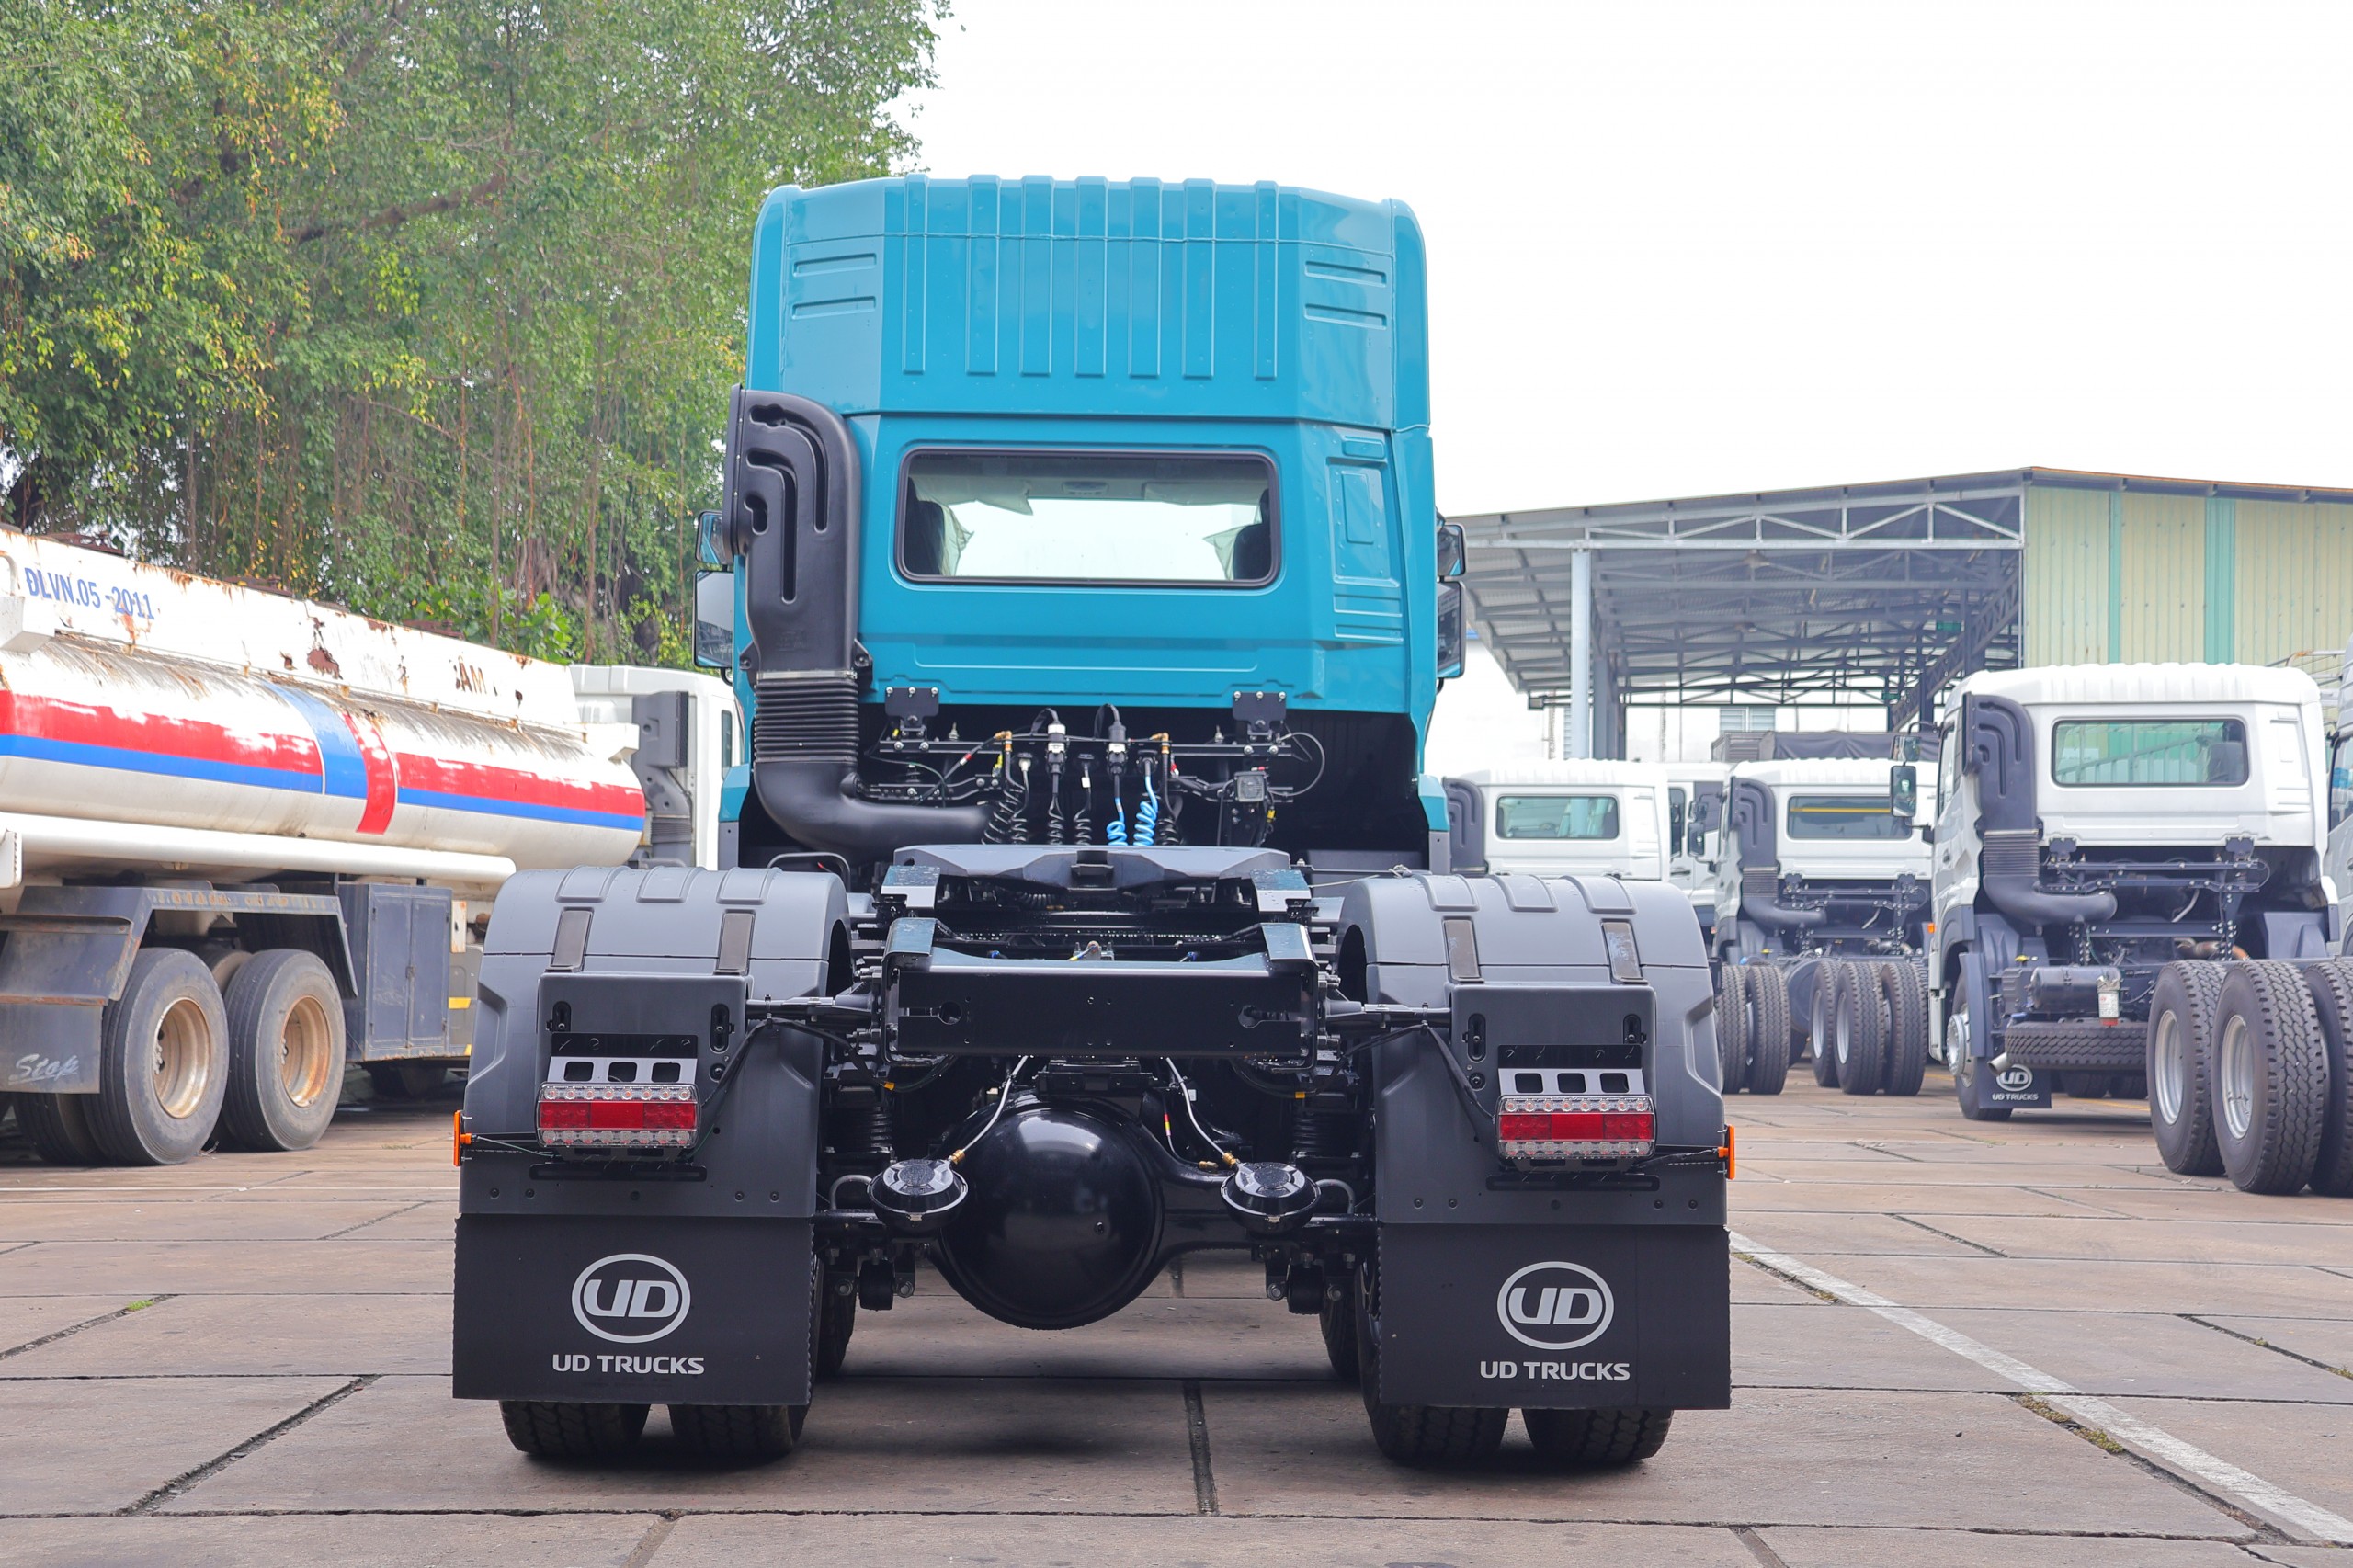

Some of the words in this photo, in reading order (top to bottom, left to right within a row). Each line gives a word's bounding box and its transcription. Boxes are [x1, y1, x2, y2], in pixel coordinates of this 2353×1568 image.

[1991, 1093, 2005, 1101] UD
[2006, 1093, 2040, 1101] TRUCKS
[583, 1279, 679, 1317] UD
[1508, 1287, 1594, 1324] UD
[552, 1354, 590, 1372] UD
[597, 1355, 705, 1375] TRUCKS
[1480, 1360, 1518, 1379] UD
[1523, 1361, 1631, 1381] TRUCKS
